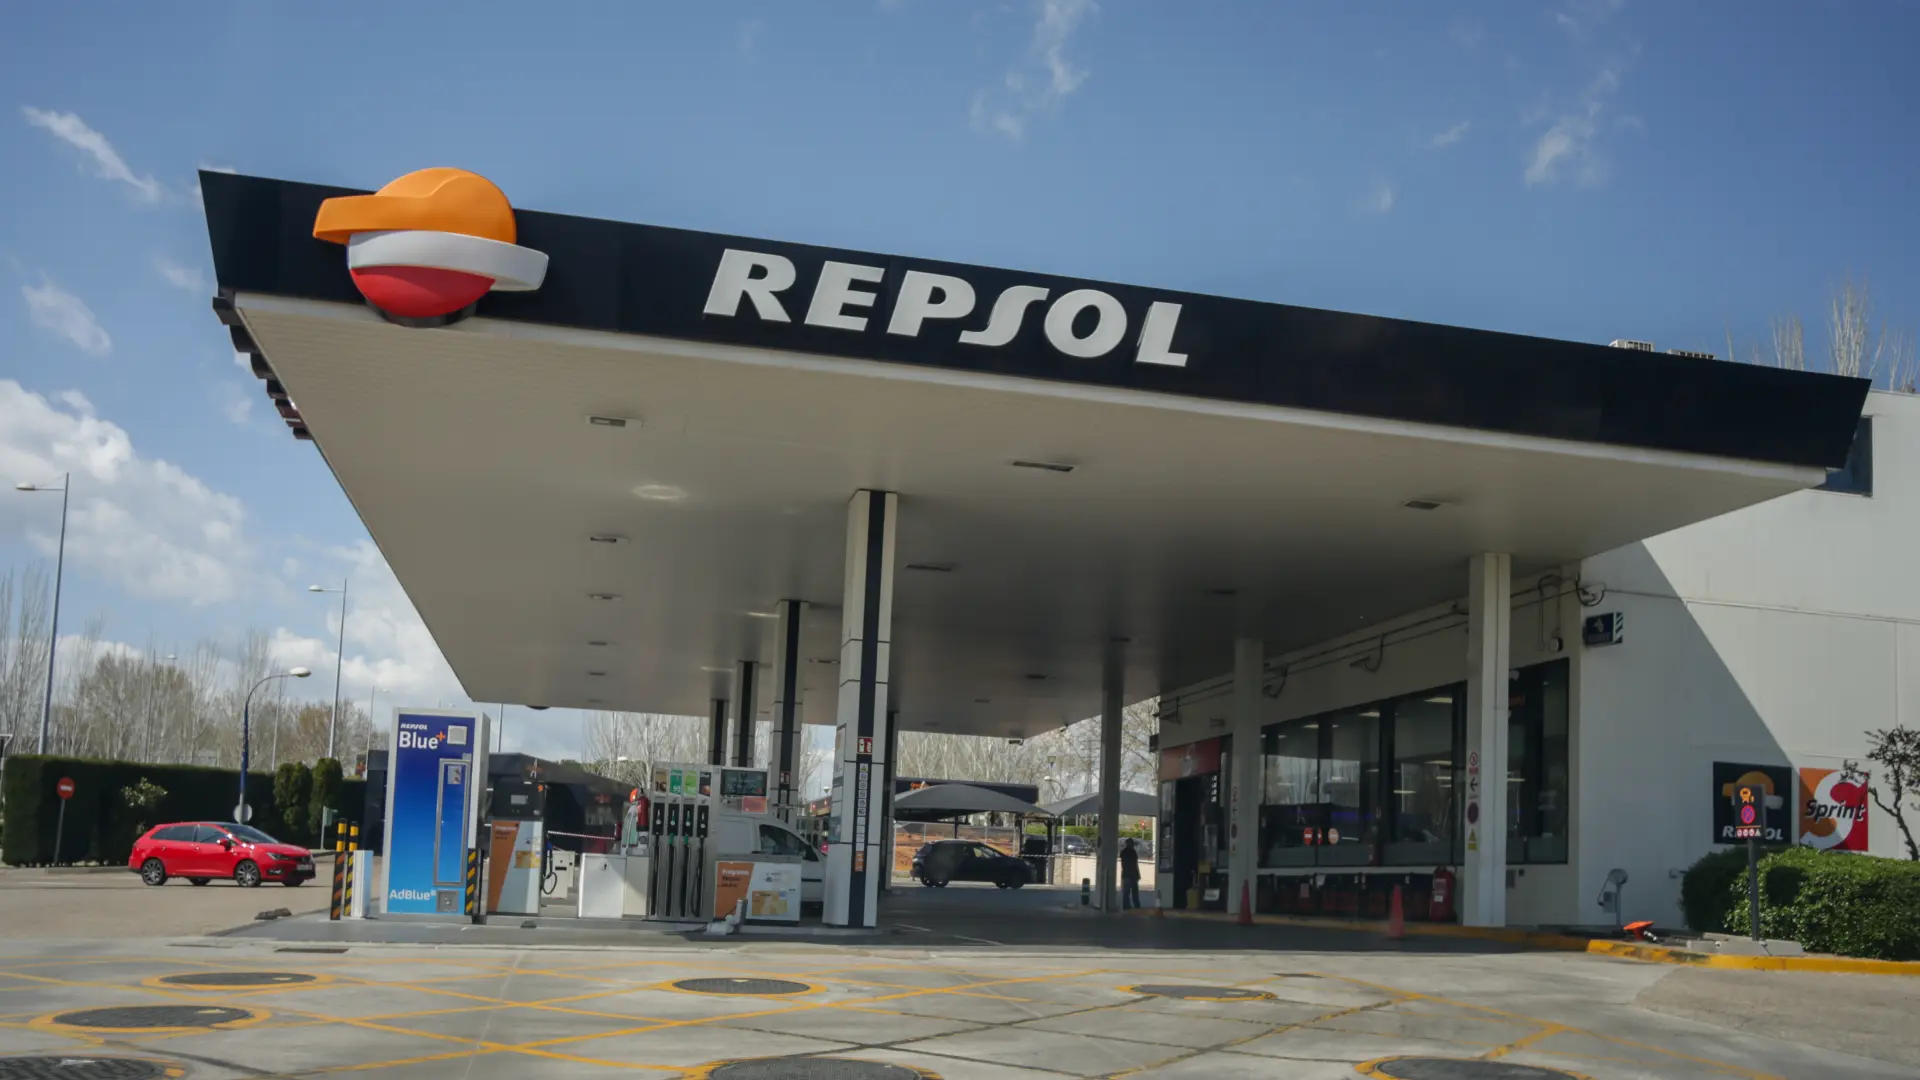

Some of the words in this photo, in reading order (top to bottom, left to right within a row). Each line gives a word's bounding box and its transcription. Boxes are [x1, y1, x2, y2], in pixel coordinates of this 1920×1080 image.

[702, 248, 1188, 368] REPSOL
[400, 723, 428, 731] REPSOL
[1804, 799, 1866, 823] Sprint
[1722, 825, 1784, 840] ROL
